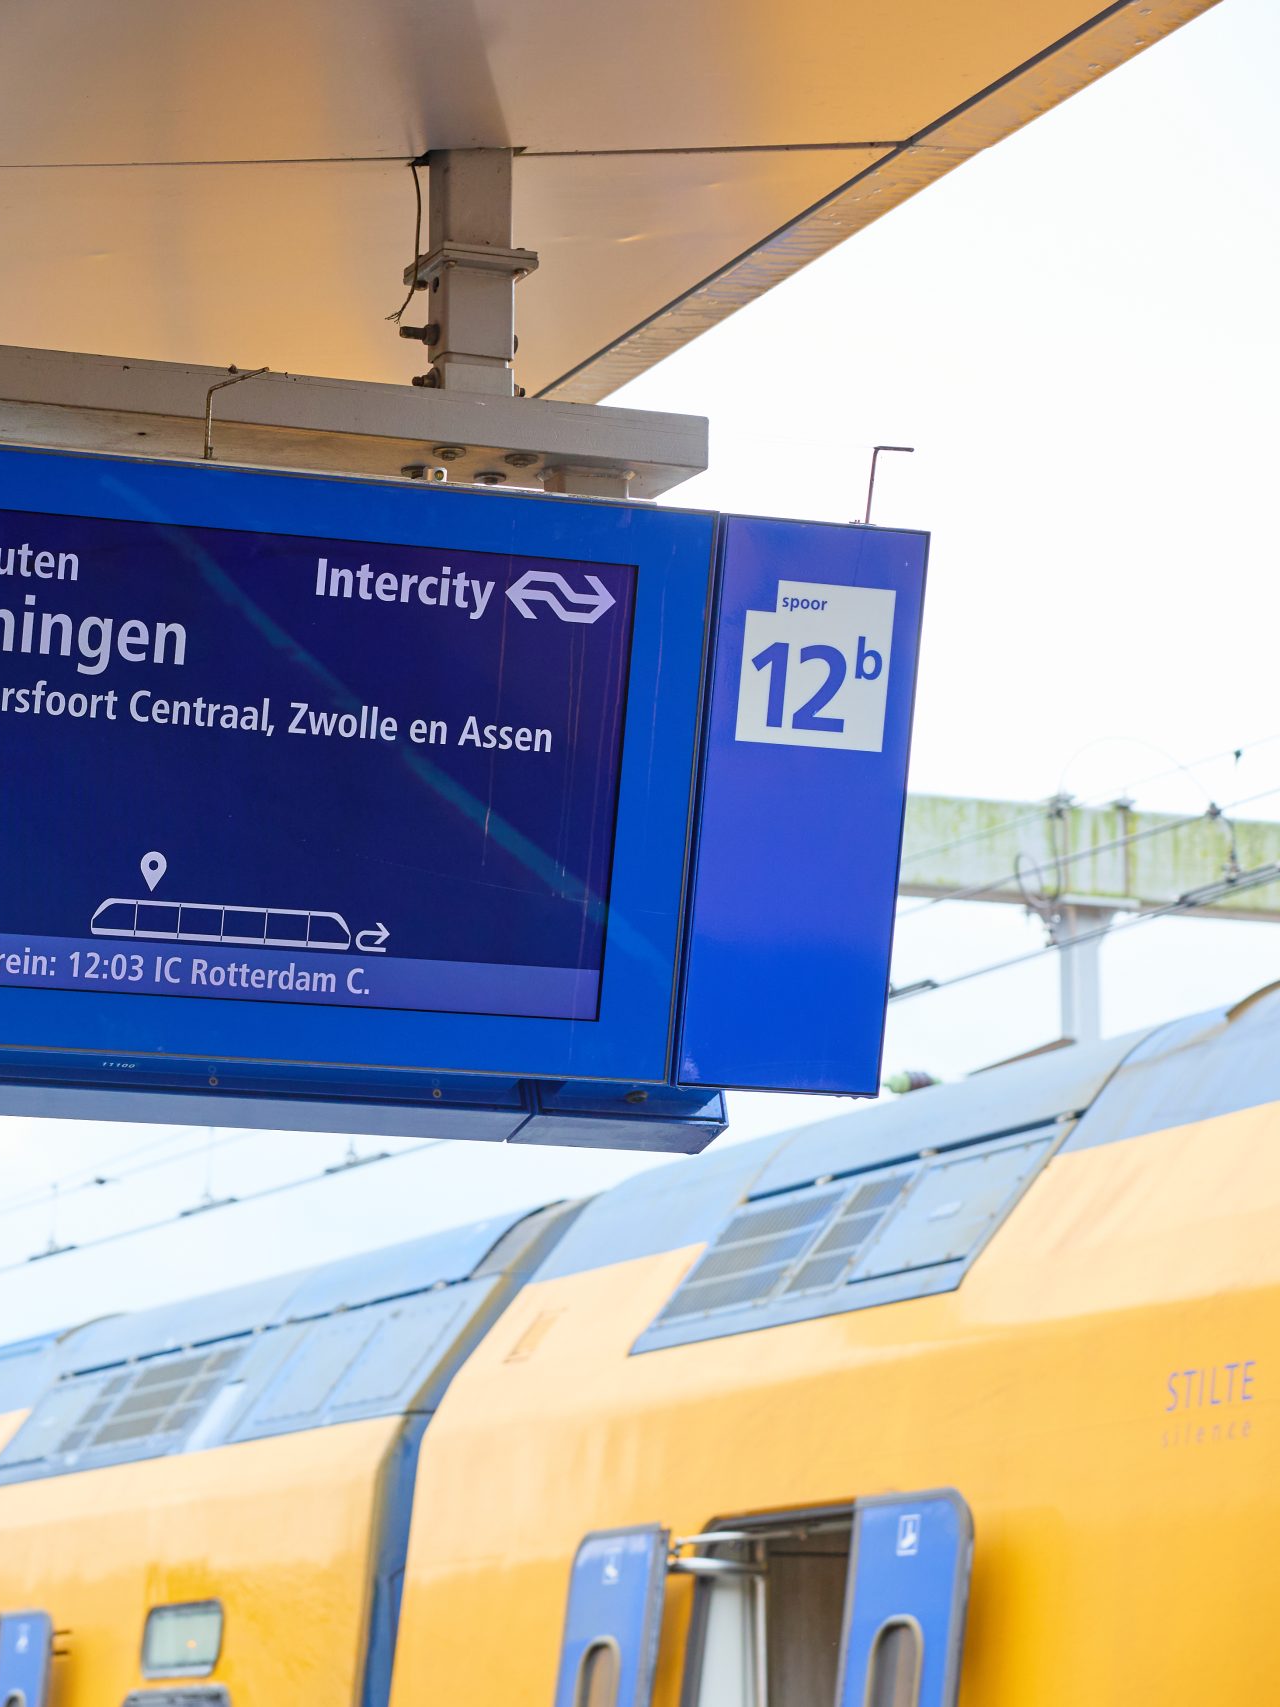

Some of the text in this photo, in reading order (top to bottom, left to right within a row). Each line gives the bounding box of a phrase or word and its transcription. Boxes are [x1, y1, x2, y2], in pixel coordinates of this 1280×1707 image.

[315, 557, 496, 620] Intercity
[782, 595, 828, 612] spoor
[129, 690, 275, 737] Centraal,
[287, 702, 398, 741] Zwolle
[409, 719, 448, 745] en
[457, 715, 552, 753] Assen
[69, 951, 144, 981] 12:03
[154, 956, 182, 984] IC
[191, 958, 336, 993] Rotterdam
[346, 967, 370, 995] C.
[1165, 1361, 1257, 1412] STILTE
